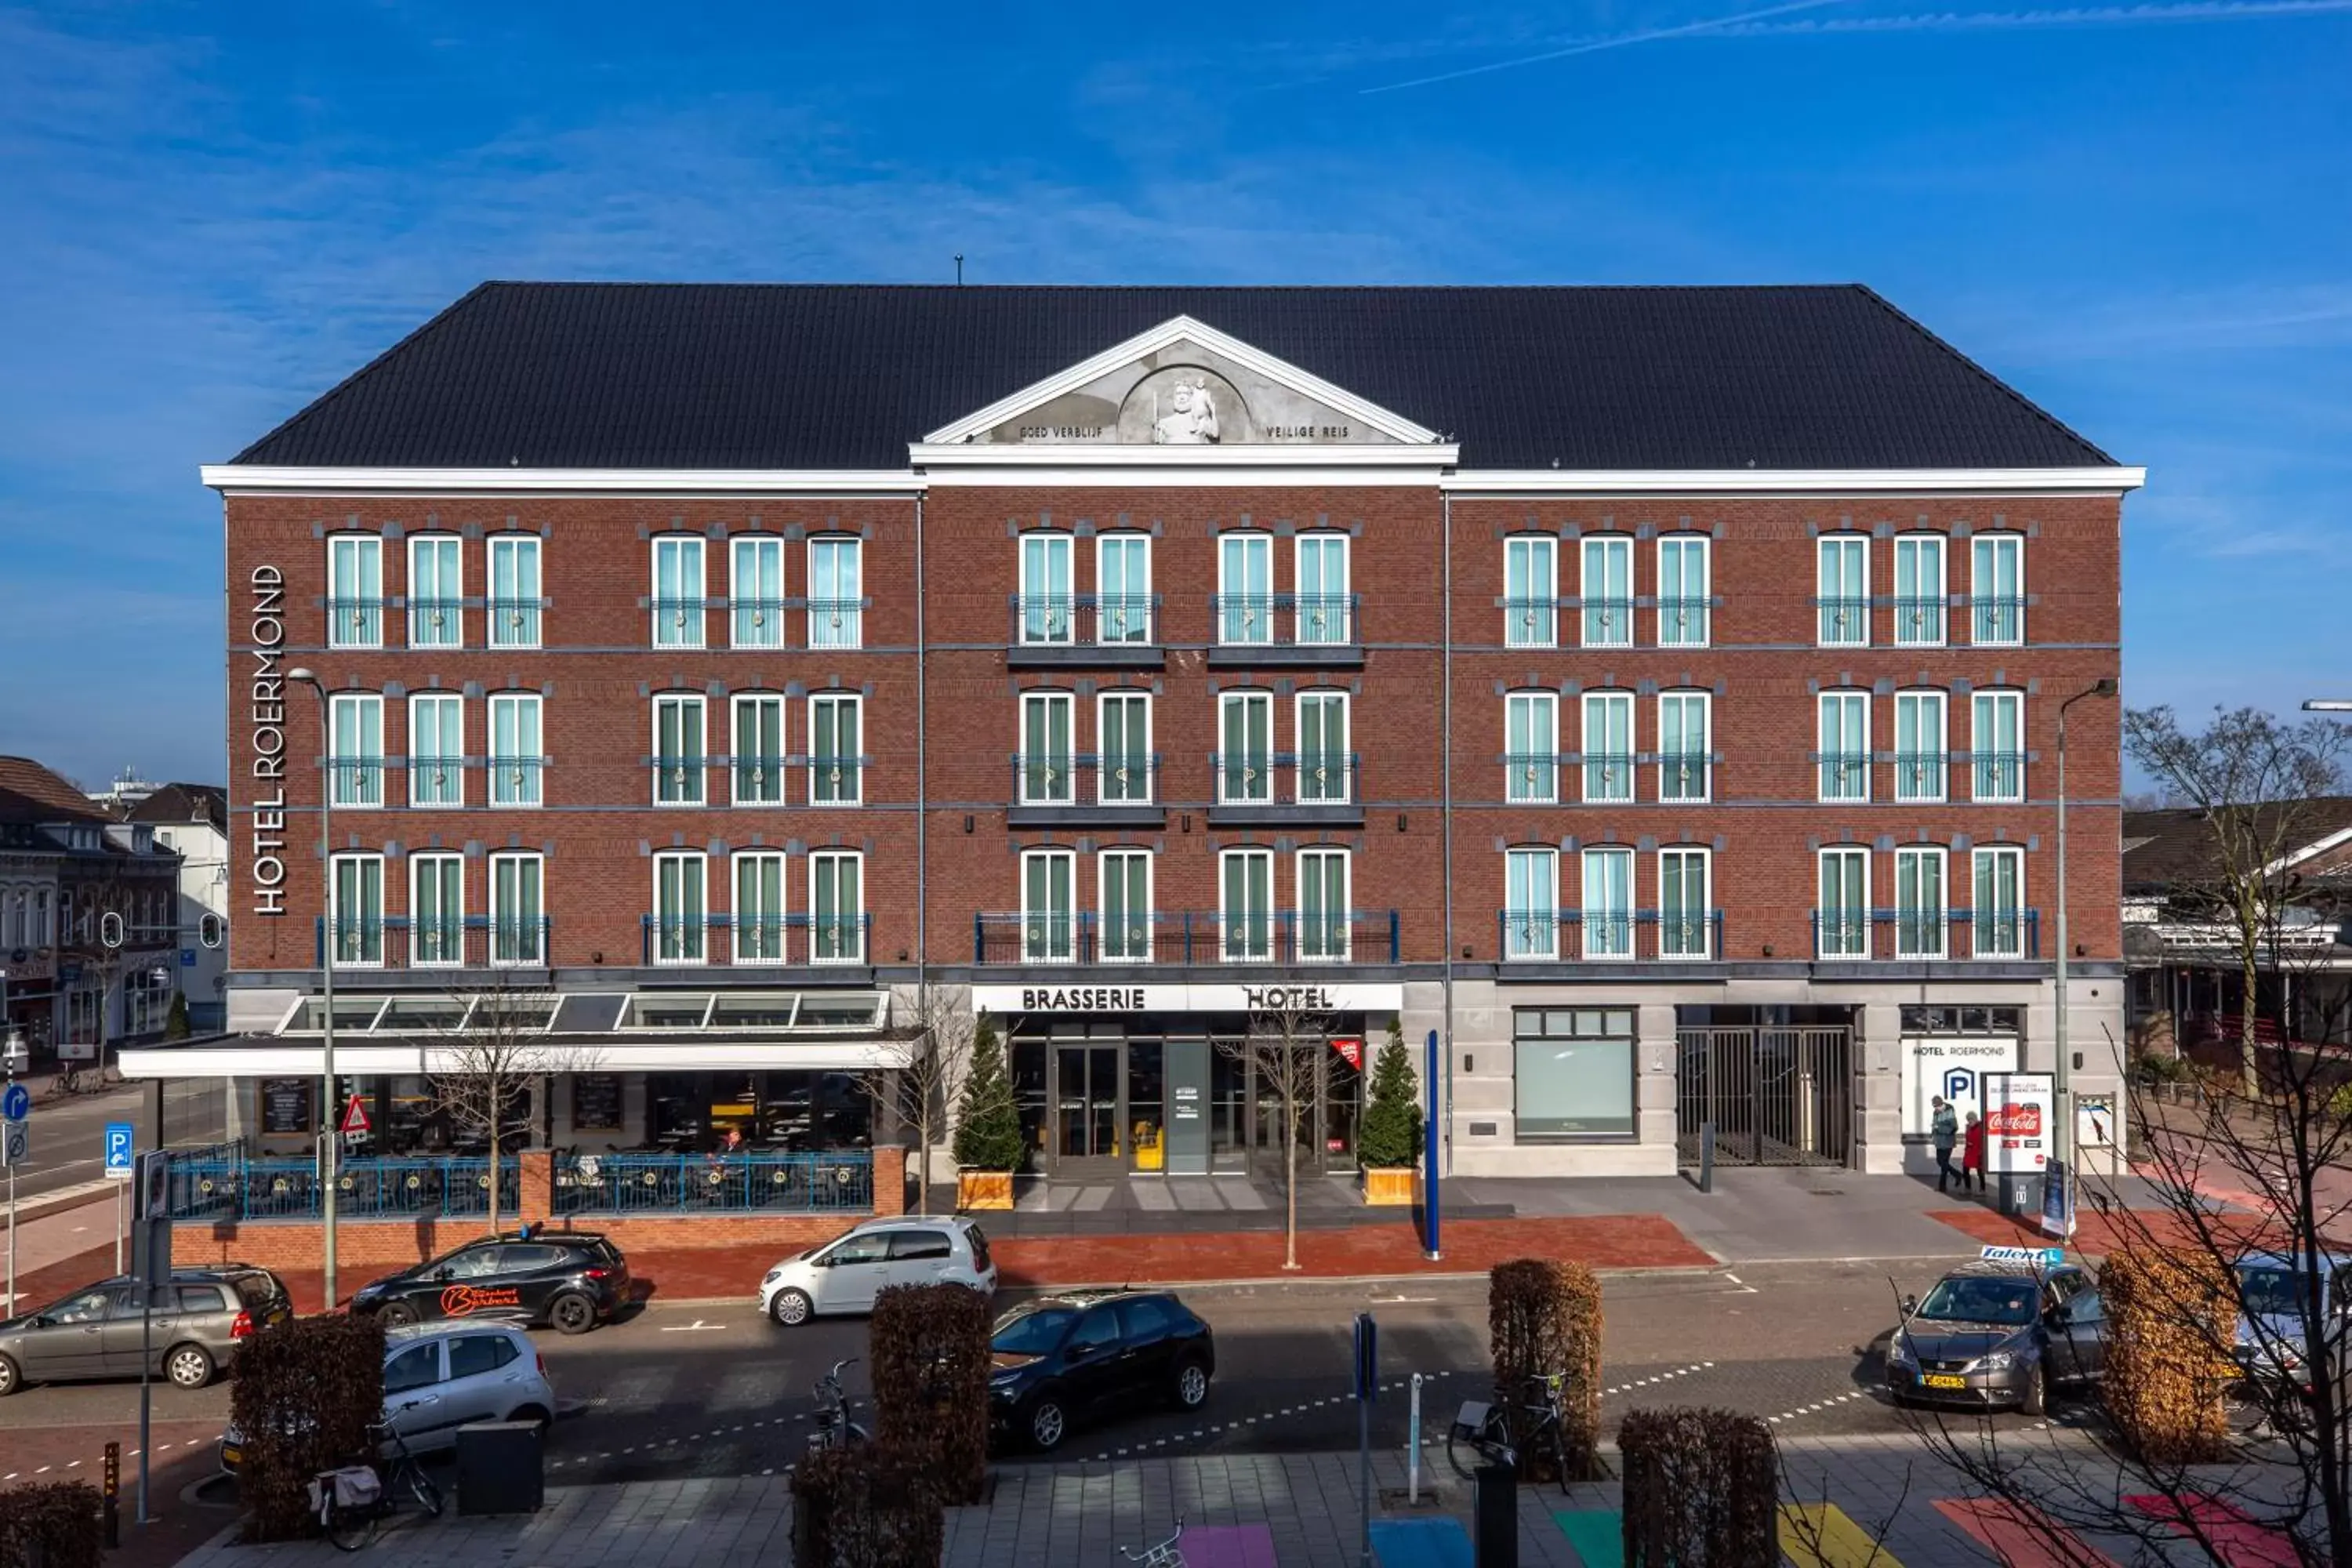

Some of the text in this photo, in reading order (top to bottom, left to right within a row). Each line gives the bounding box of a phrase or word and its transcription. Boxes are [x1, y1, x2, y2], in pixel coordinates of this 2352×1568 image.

[1020, 427, 1102, 437] GOED VERBLIJF
[1267, 426, 1348, 437] VEILIGE REIS
[252, 564, 284, 914] HOTEL ROERMOND
[1022, 989, 1145, 1010] BRASSERIE
[1247, 988, 1333, 1009] HOTEL
[1913, 1047, 2005, 1057] HOTEL ROERMOND
[1950, 1076, 1969, 1099] P
[112, 1133, 126, 1152] P
